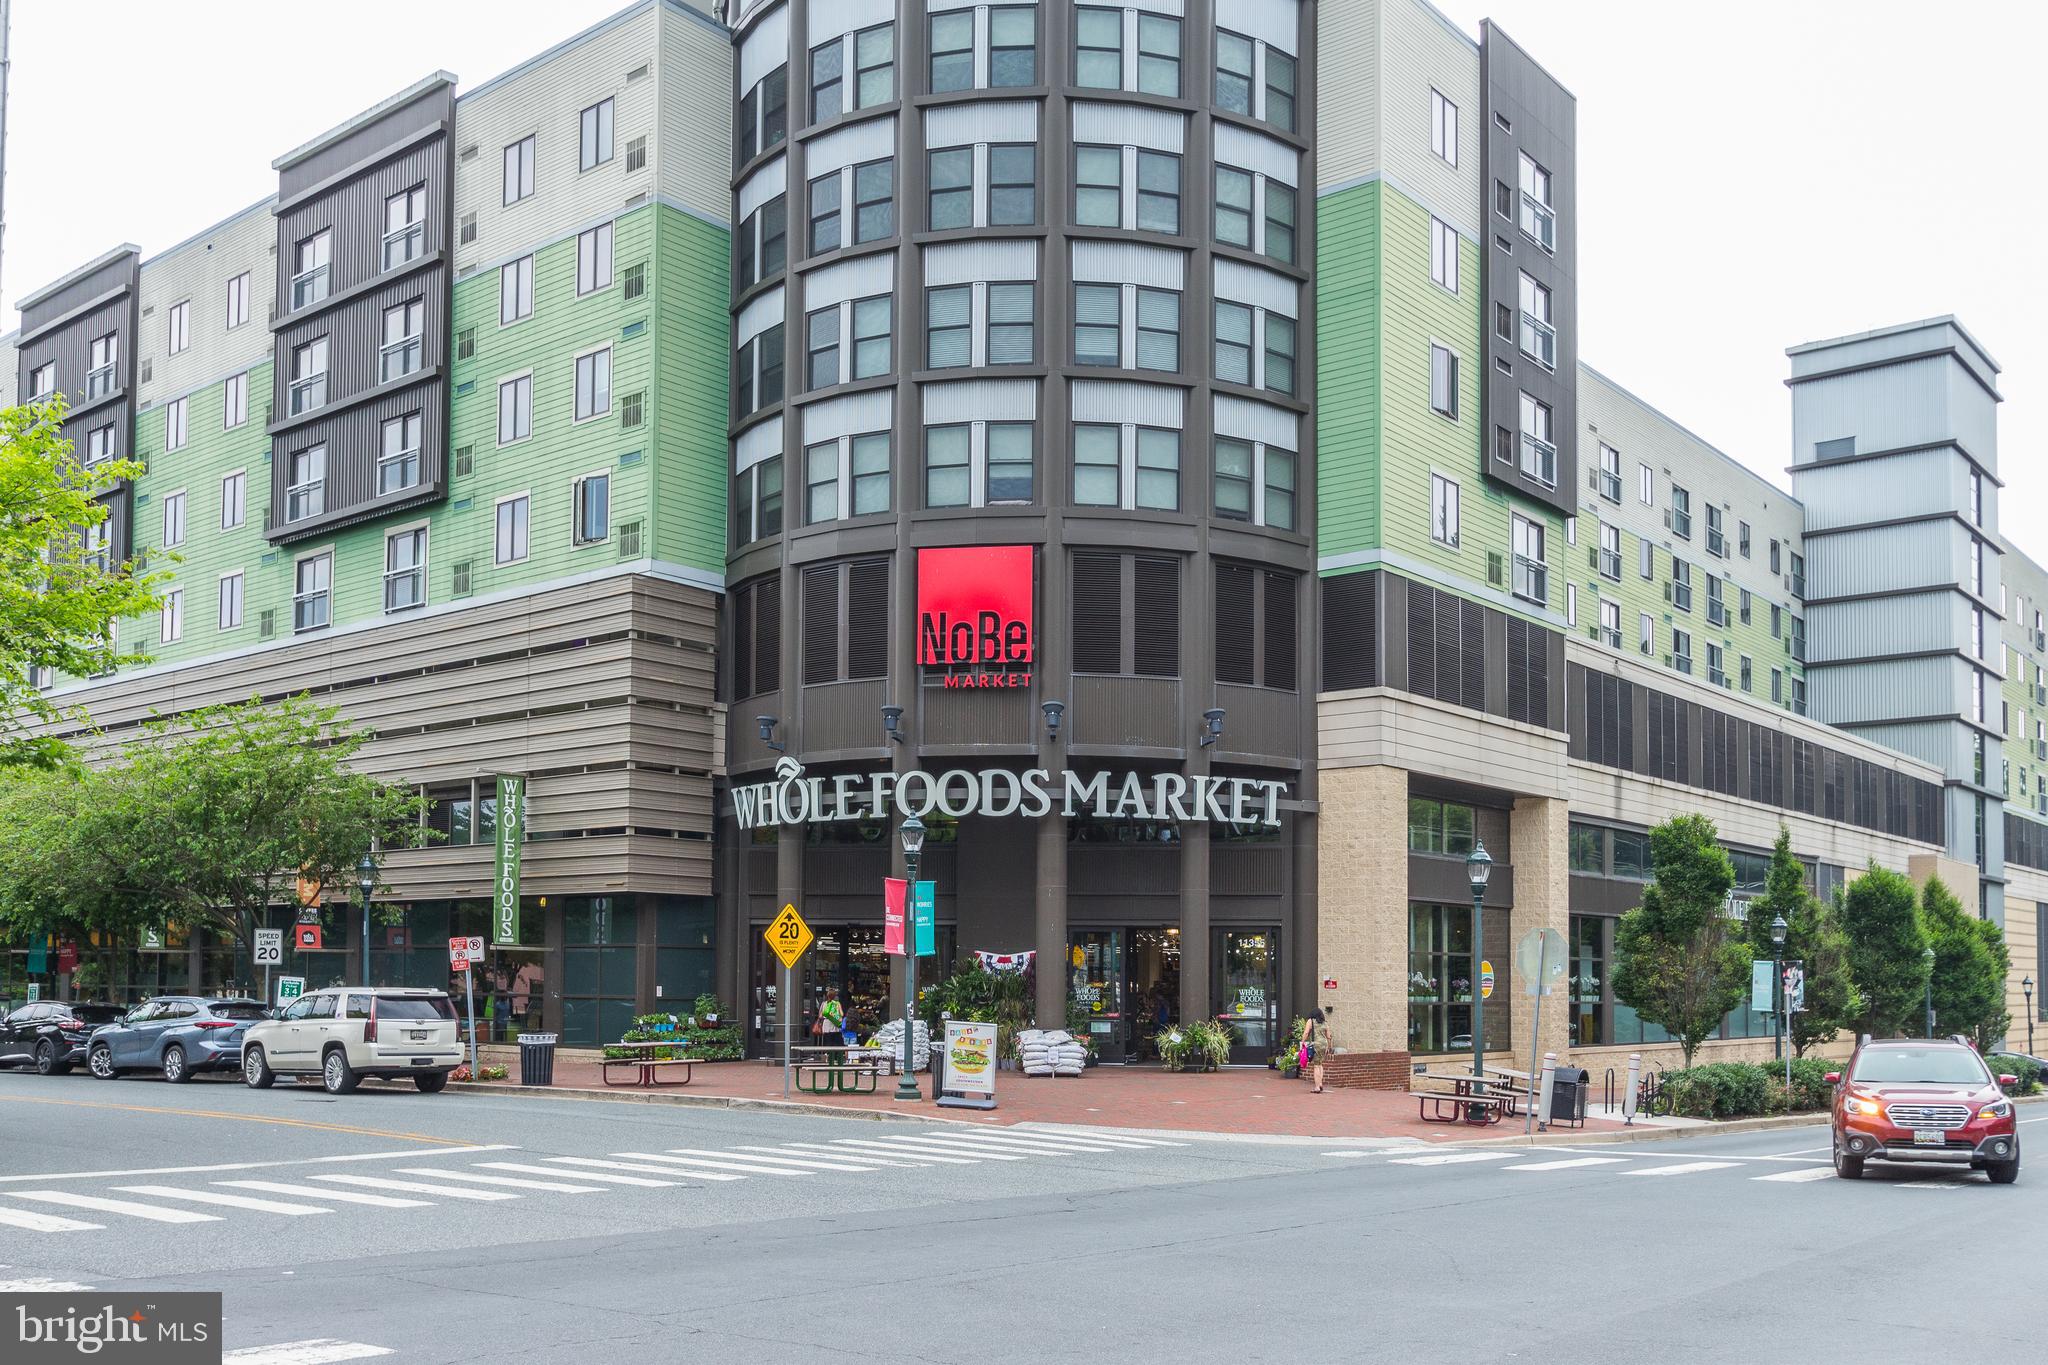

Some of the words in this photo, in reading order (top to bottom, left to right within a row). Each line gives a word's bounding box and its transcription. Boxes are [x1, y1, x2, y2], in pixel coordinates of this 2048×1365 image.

[920, 609, 1029, 664] NoBe
[944, 673, 1032, 689] MARKET
[731, 756, 865, 830] WHOLE
[868, 768, 1052, 819] FOODS
[1061, 768, 1288, 827] MARKET
[502, 779, 519, 858] WHOLE
[501, 862, 515, 937] FOODS
[779, 922, 800, 940] 20
[257, 947, 279, 960] 20
[1075, 987, 1101, 995] WHOLE
[1238, 986, 1265, 996] WHOLE
